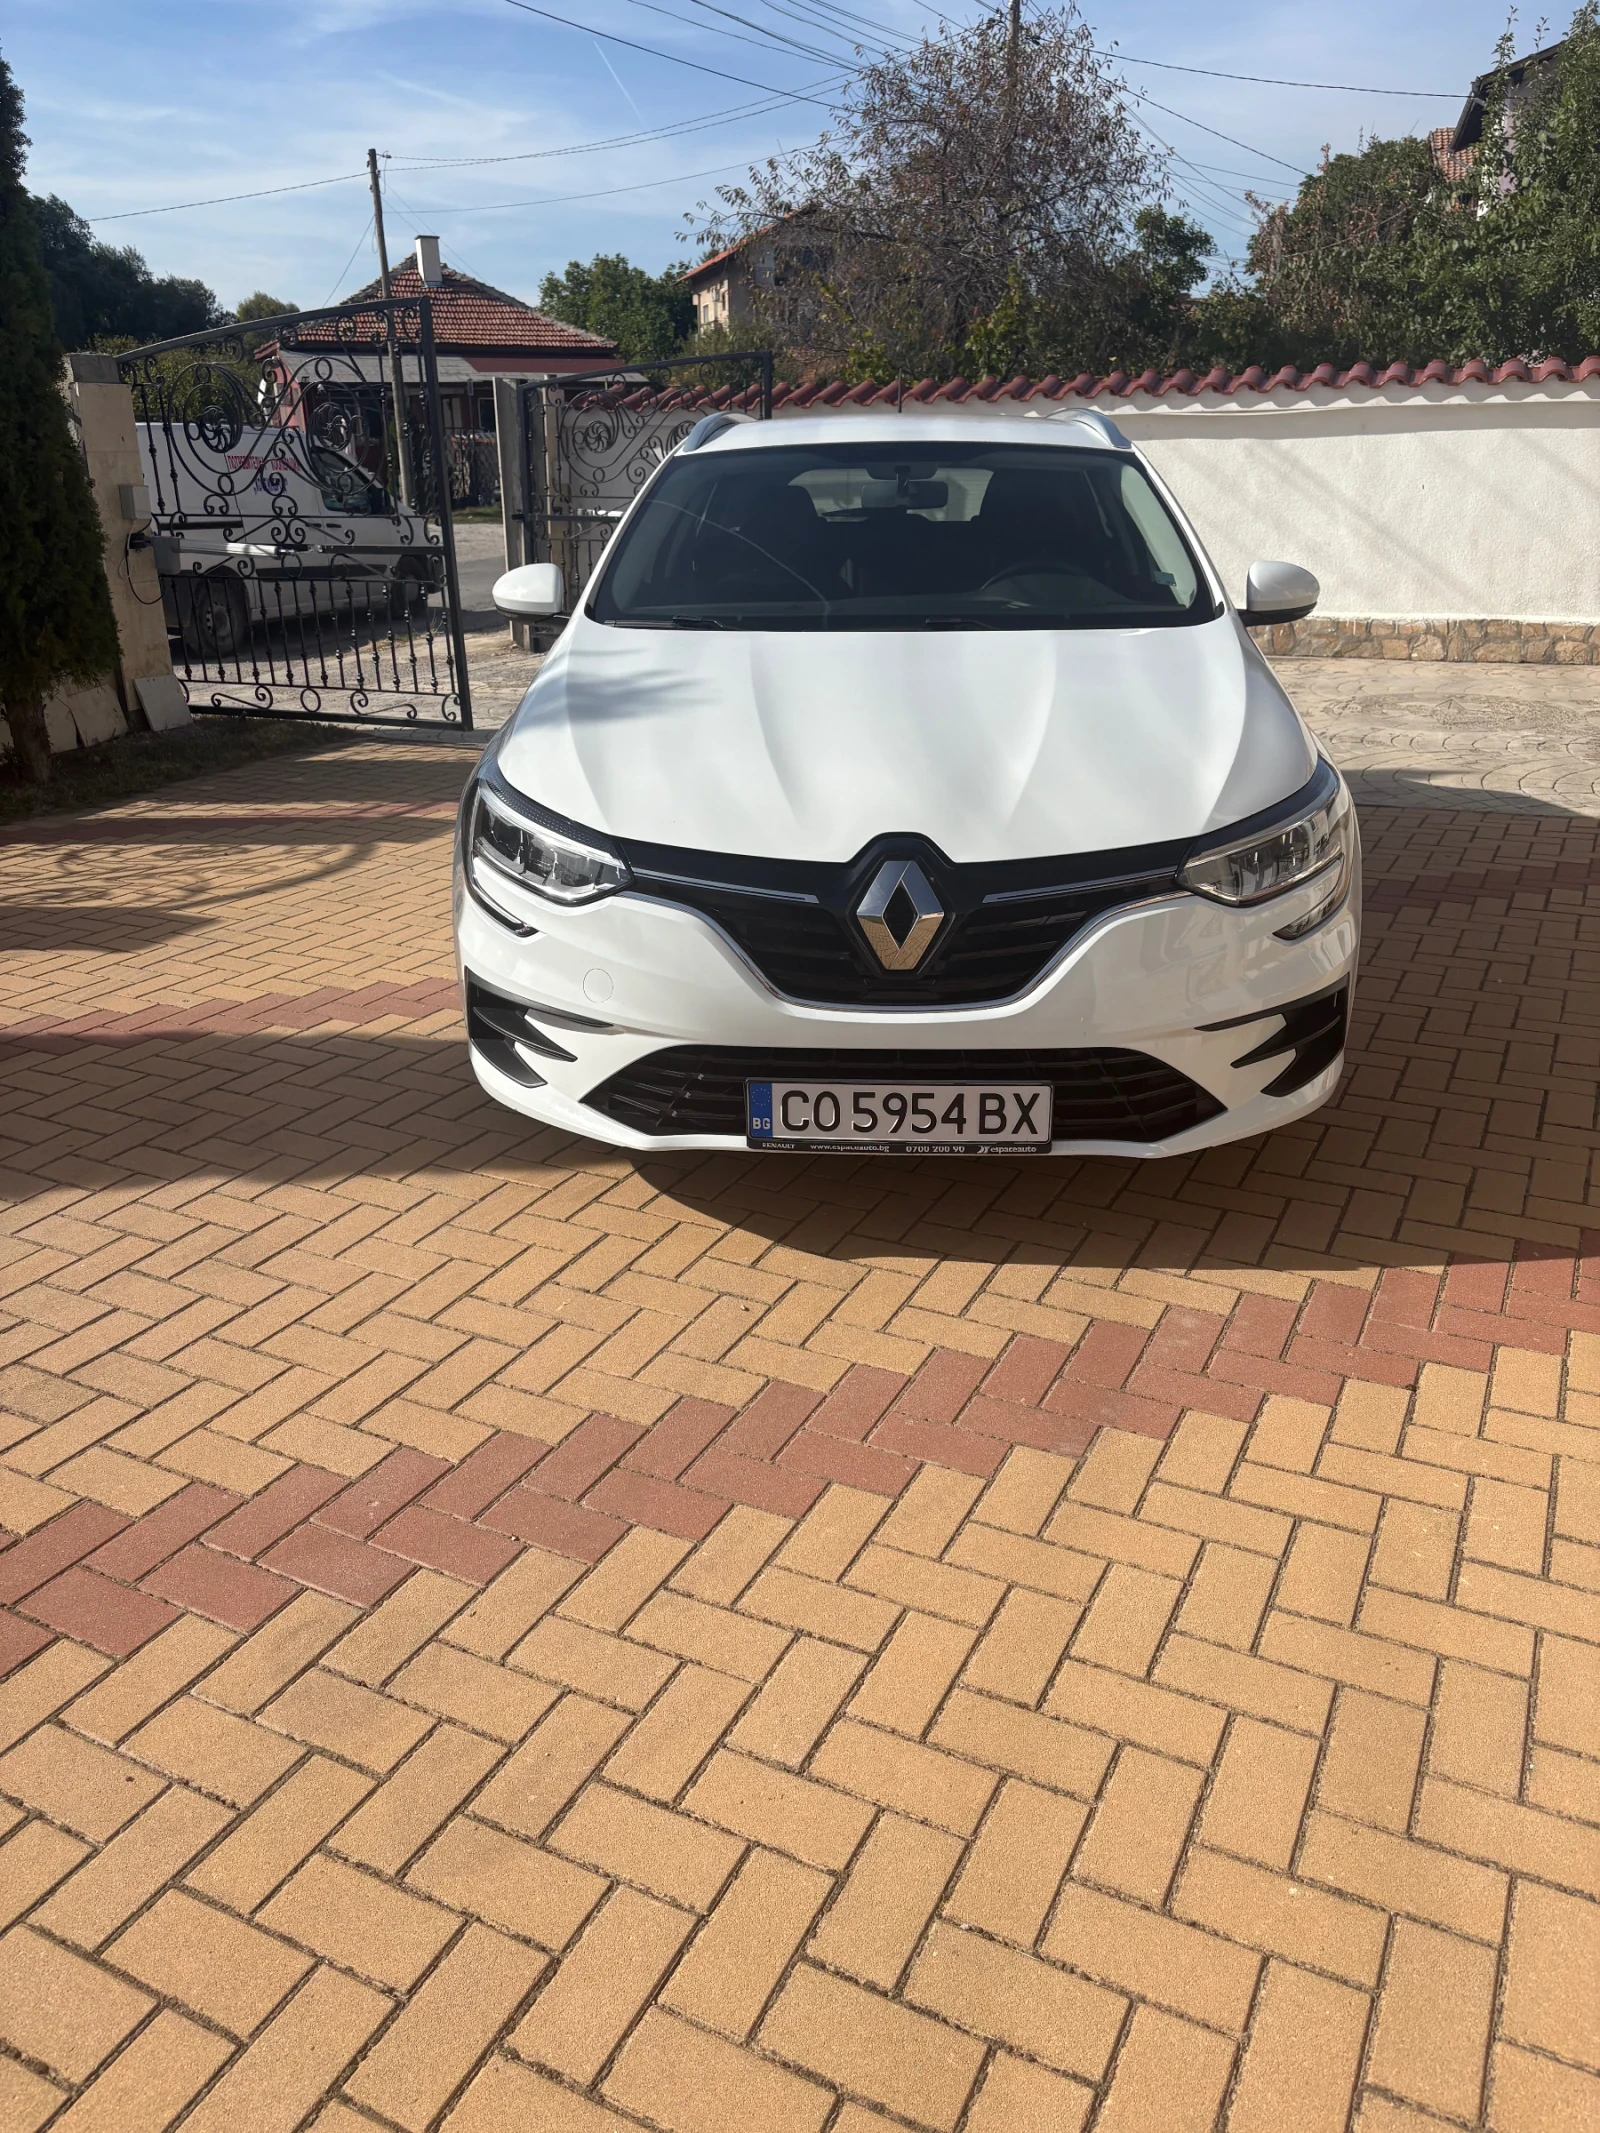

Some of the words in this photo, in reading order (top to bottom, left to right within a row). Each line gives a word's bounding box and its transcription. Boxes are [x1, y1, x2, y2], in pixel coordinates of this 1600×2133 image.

[781, 1090, 841, 1132] CO
[852, 1092, 967, 1134] 5954
[978, 1092, 1041, 1135] BX
[752, 1118, 771, 1130] BG
[762, 1142, 796, 1150] RENAULT
[810, 1144, 890, 1153] www.espaceauto.bg
[905, 1145, 930, 1153] 0700
[932, 1145, 950, 1153] 200
[953, 1145, 965, 1153] 90
[990, 1145, 1037, 1154] espaceauto
